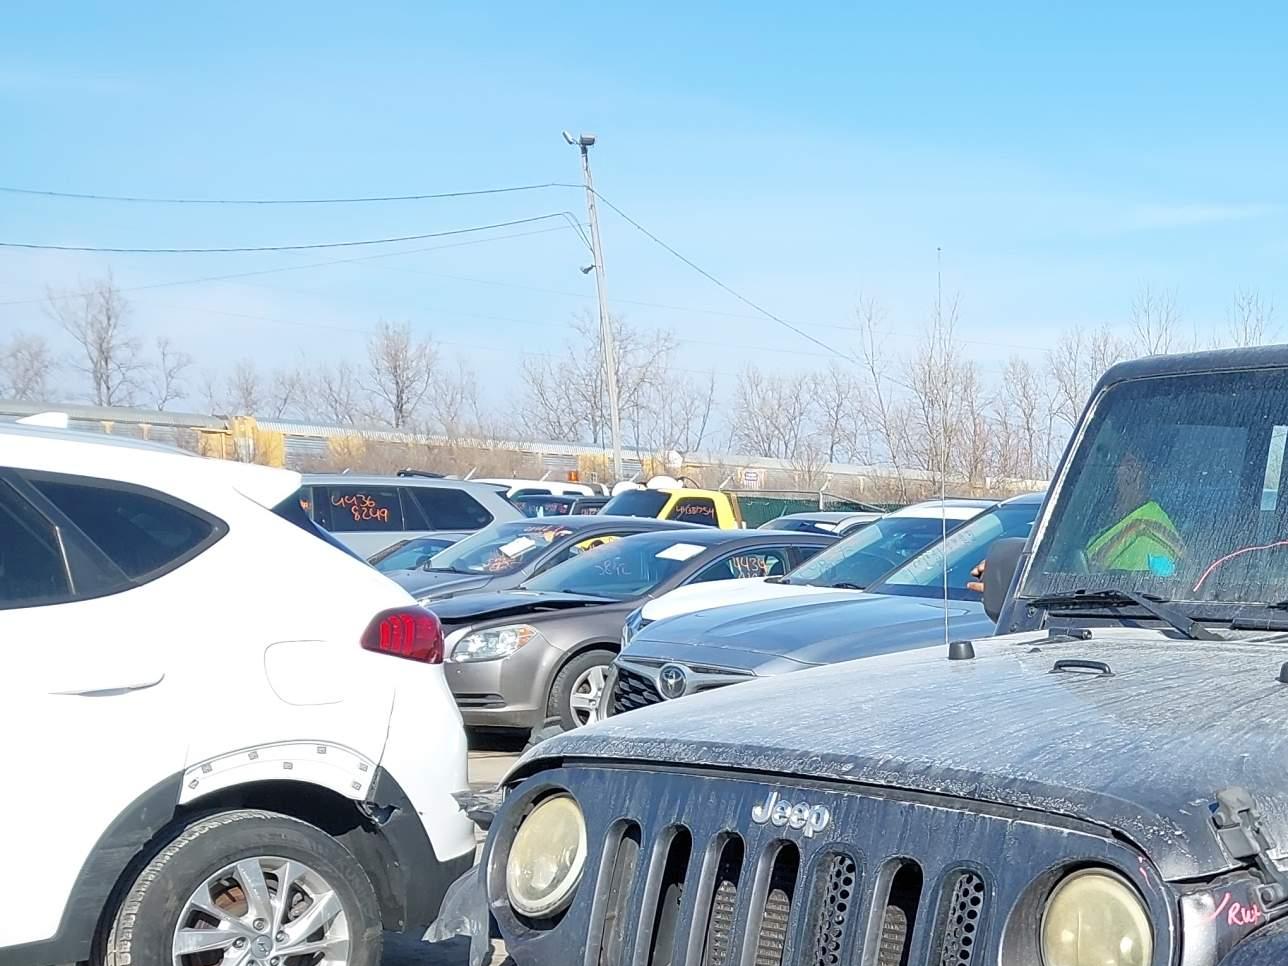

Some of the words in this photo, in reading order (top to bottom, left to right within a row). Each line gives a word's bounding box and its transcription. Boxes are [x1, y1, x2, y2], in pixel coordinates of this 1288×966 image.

[331, 494, 376, 507] 4436
[351, 505, 389, 522] 8249
[751, 791, 830, 838] Jeep
